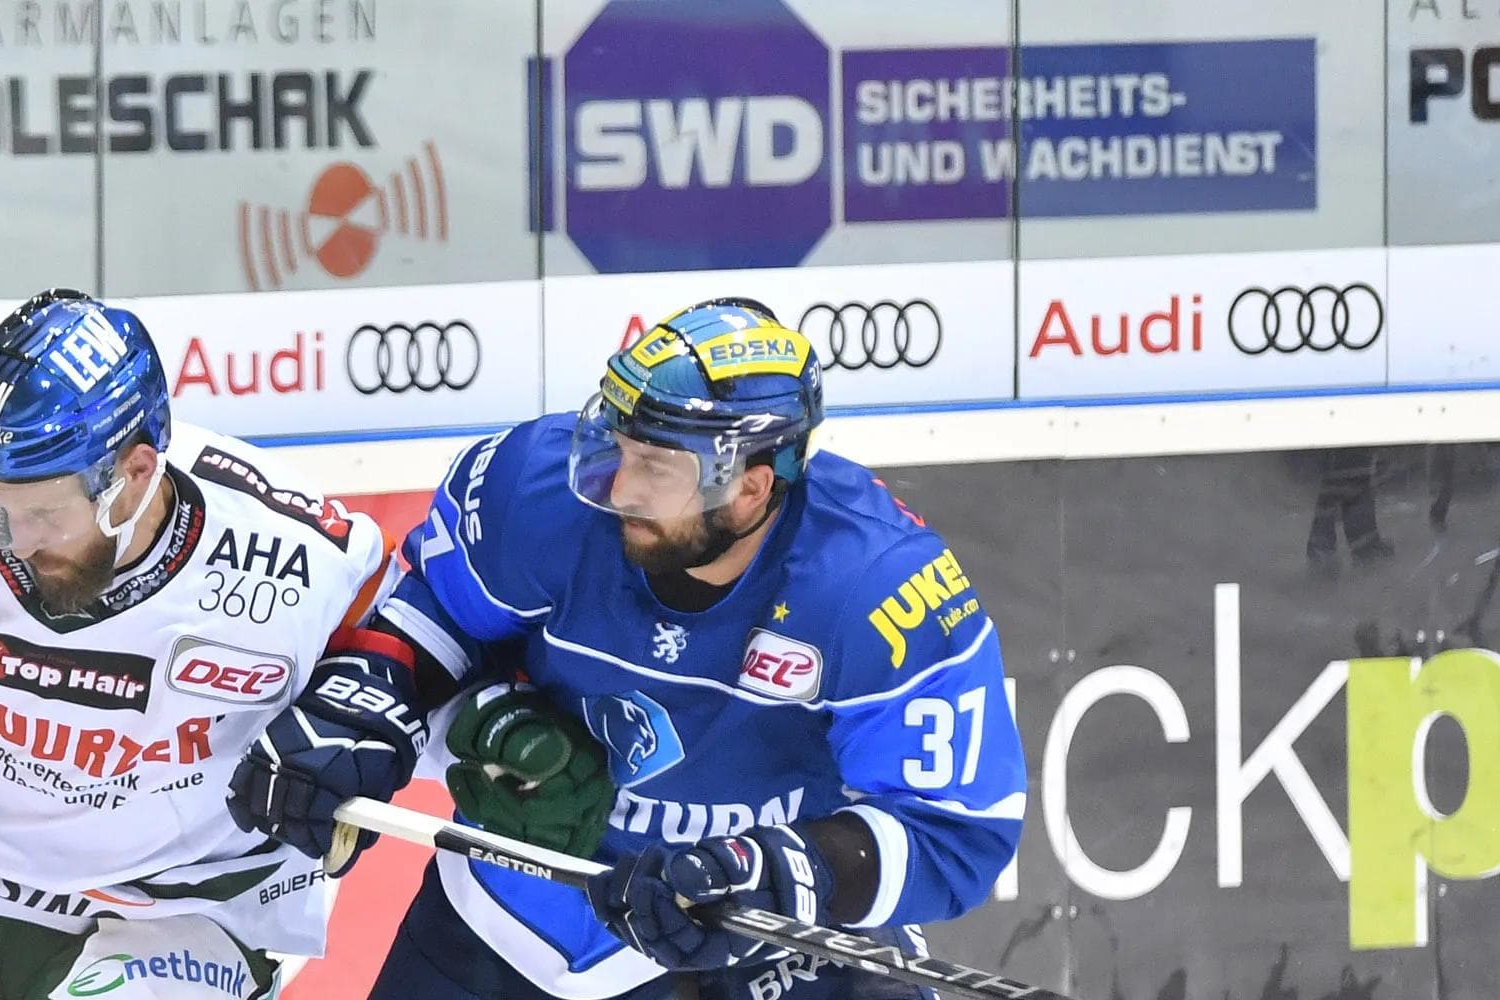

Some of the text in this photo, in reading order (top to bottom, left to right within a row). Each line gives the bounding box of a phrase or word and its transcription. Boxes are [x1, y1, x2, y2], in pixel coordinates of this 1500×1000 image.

[857, 72, 1186, 126] SICHERHEITS-
[575, 95, 825, 192] SWD
[857, 132, 1283, 187] UND WACHDIENST
[50, 307, 129, 394] LEW
[709, 339, 798, 361] EDEKA
[1029, 295, 1203, 359] Audi
[172, 332, 325, 398] Audi
[205, 527, 311, 590] AHA
[199, 570, 301, 624] 360°
[868, 548, 971, 670] JUKE!
[1, 655, 62, 688] Top
[68, 668, 146, 700] Hair
[902, 686, 988, 789] 37
[468, 846, 553, 881] EASTON
[122, 950, 247, 998] netbank
[722, 908, 1041, 998] STEALTH
